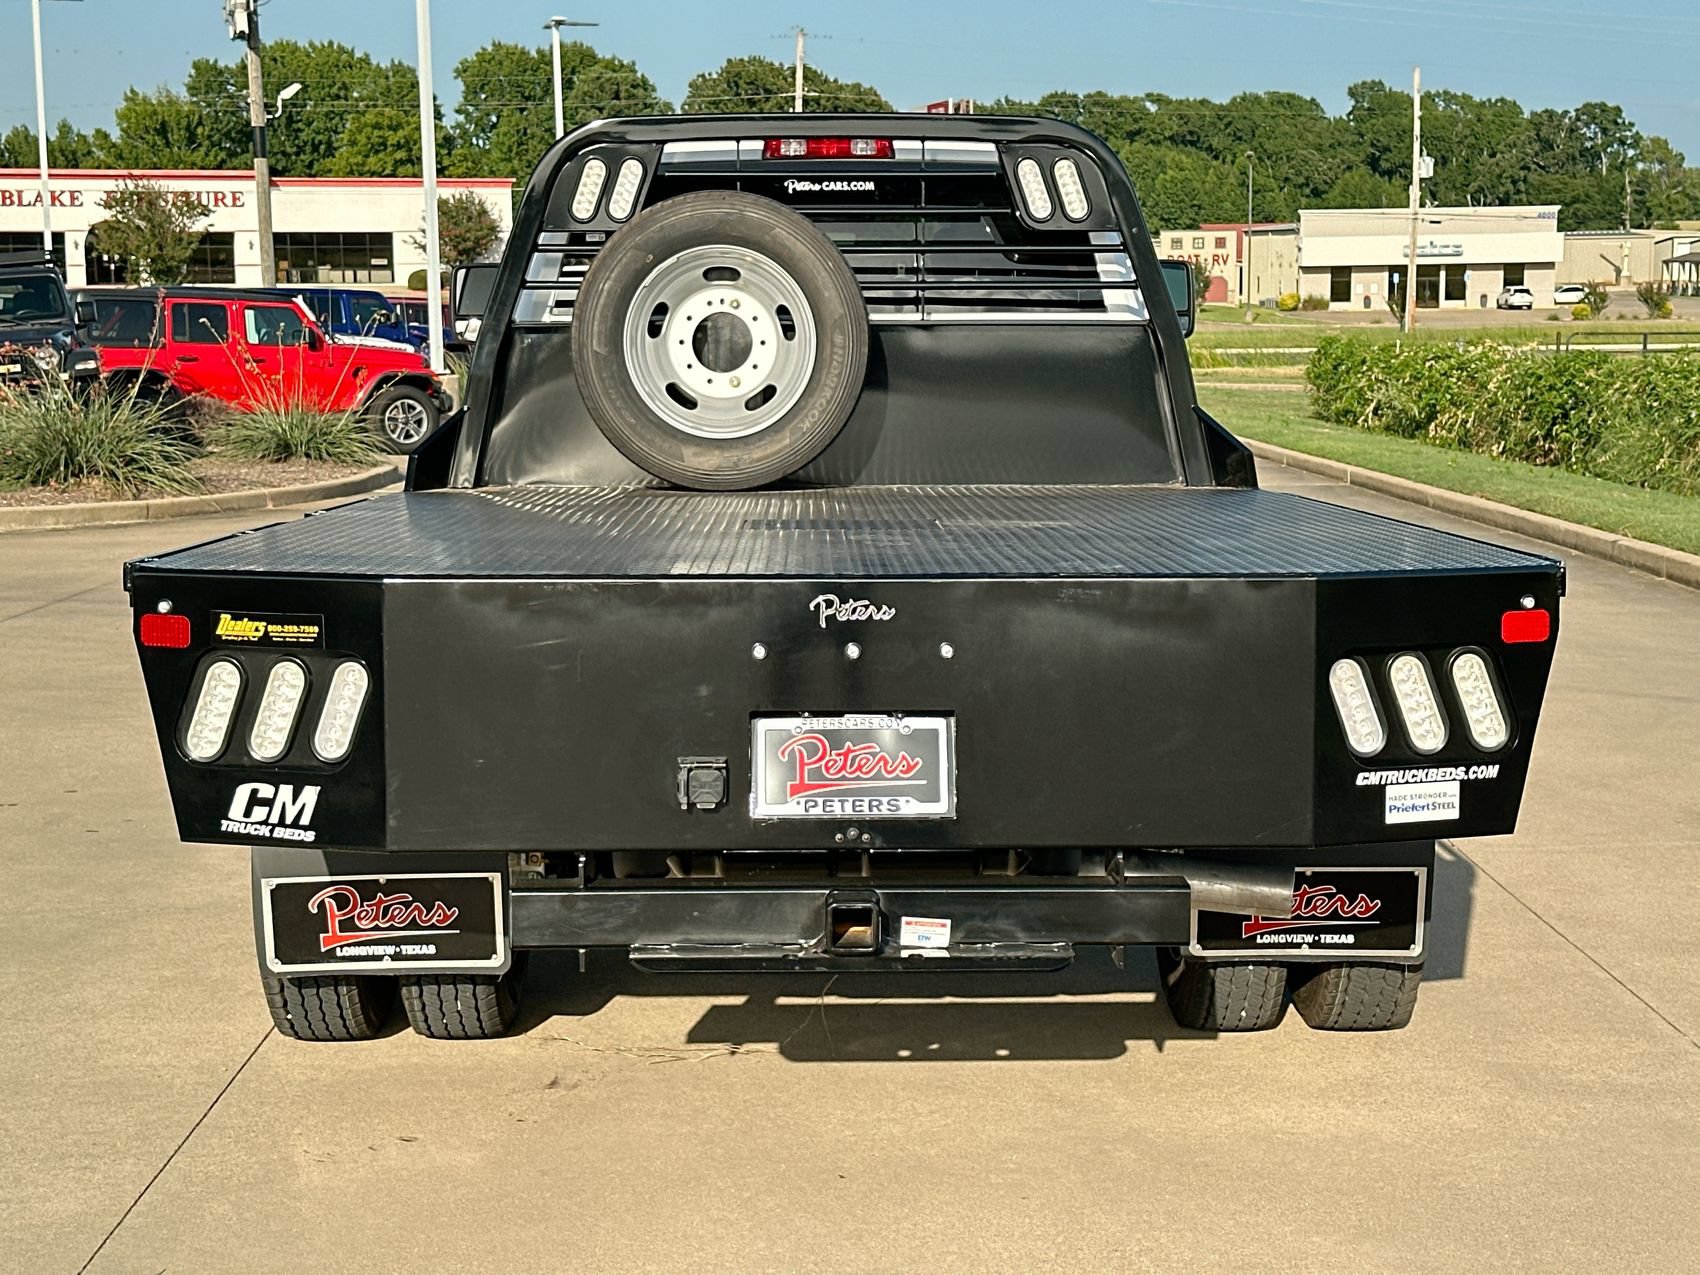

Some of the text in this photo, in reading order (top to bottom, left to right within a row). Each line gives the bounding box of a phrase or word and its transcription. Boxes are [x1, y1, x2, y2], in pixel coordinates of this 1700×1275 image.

[0, 189, 84, 207] BLAKE
[1212, 254, 1229, 266] RV
[809, 594, 896, 628] Peters
[216, 614, 267, 636] Dealers
[778, 733, 922, 790] Peters
[228, 782, 321, 825] CM
[804, 798, 902, 813] PETERS
[220, 820, 316, 842] TRUCK BEDS
[308, 885, 459, 938] Peters
